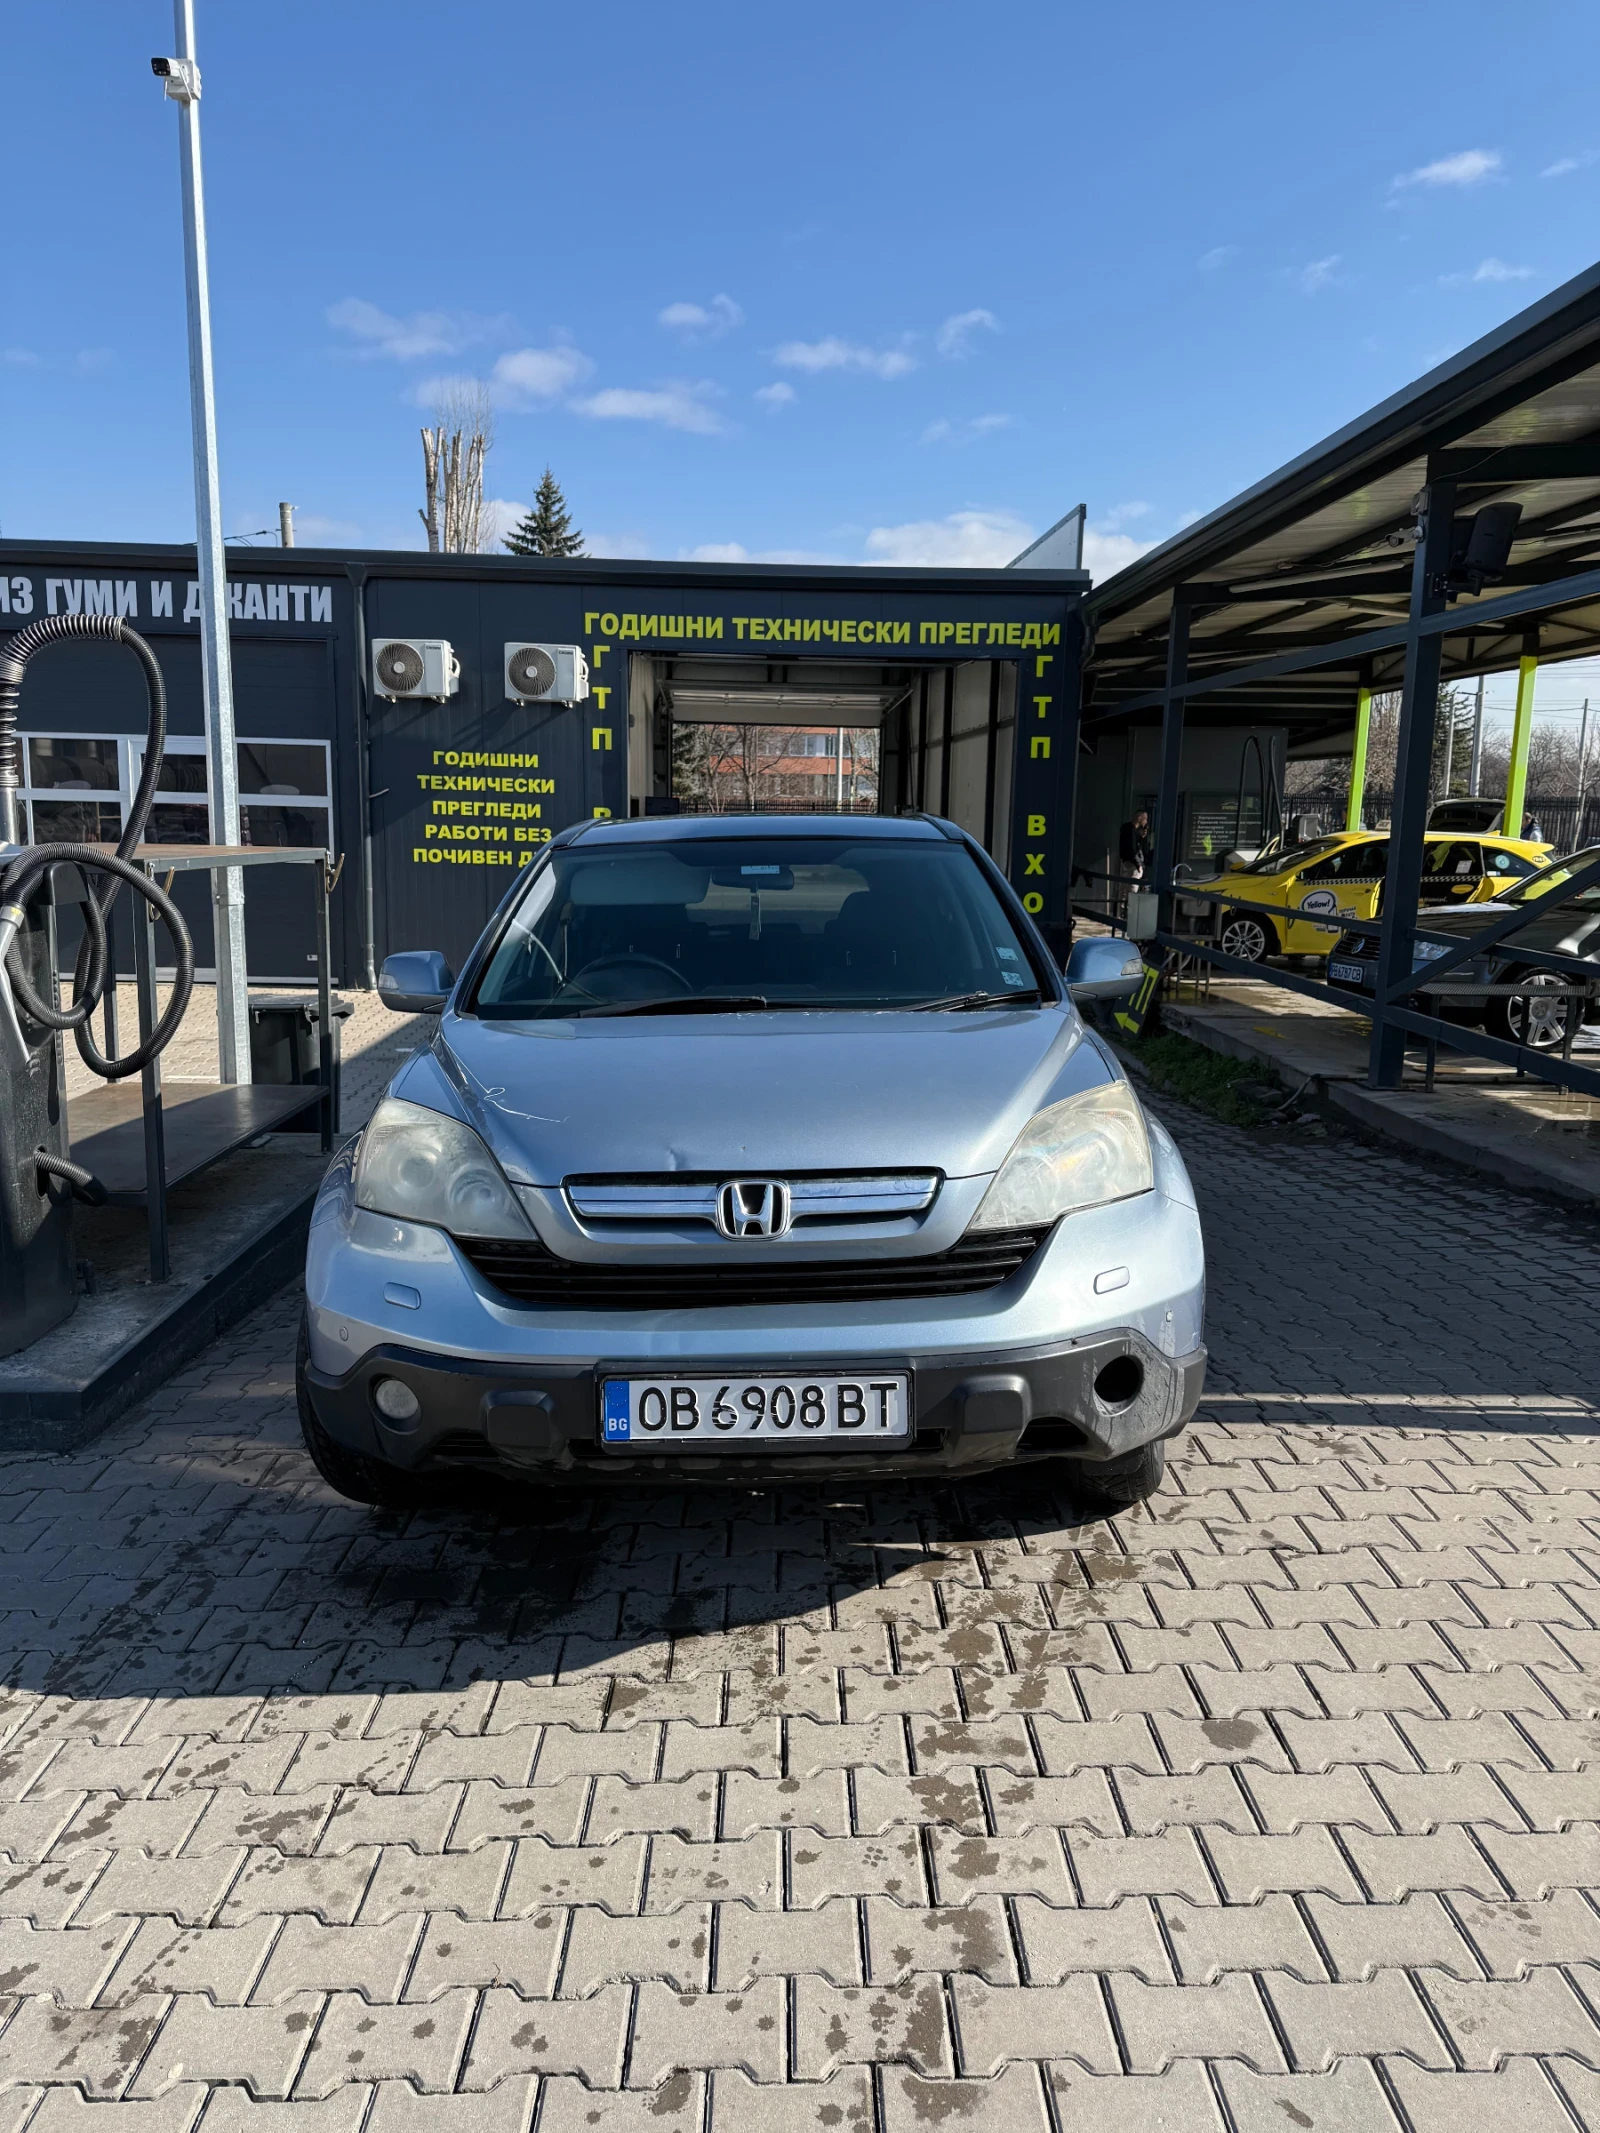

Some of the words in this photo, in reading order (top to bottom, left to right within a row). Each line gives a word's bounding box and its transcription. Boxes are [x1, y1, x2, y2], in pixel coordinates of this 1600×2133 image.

[45, 578, 138, 617] ГУМИ
[150, 580, 173, 617] И
[584, 612, 722, 641] ГОДИШНИ
[733, 617, 911, 644] ТЕХНИЧЕСКИ
[919, 623, 1061, 649] ПРЕГЛЕДИ
[433, 751, 539, 769] ГОДИШНИ
[417, 775, 555, 794] ТЕХНИЧЕСКИ
[432, 800, 541, 820] ПРЕГЛЕДИ
[425, 824, 508, 842] РАБОТИ
[514, 827, 552, 843] БЕЗ
[413, 848, 513, 866] ПОЧИВЕН
[608, 1417, 628, 1432] BG
